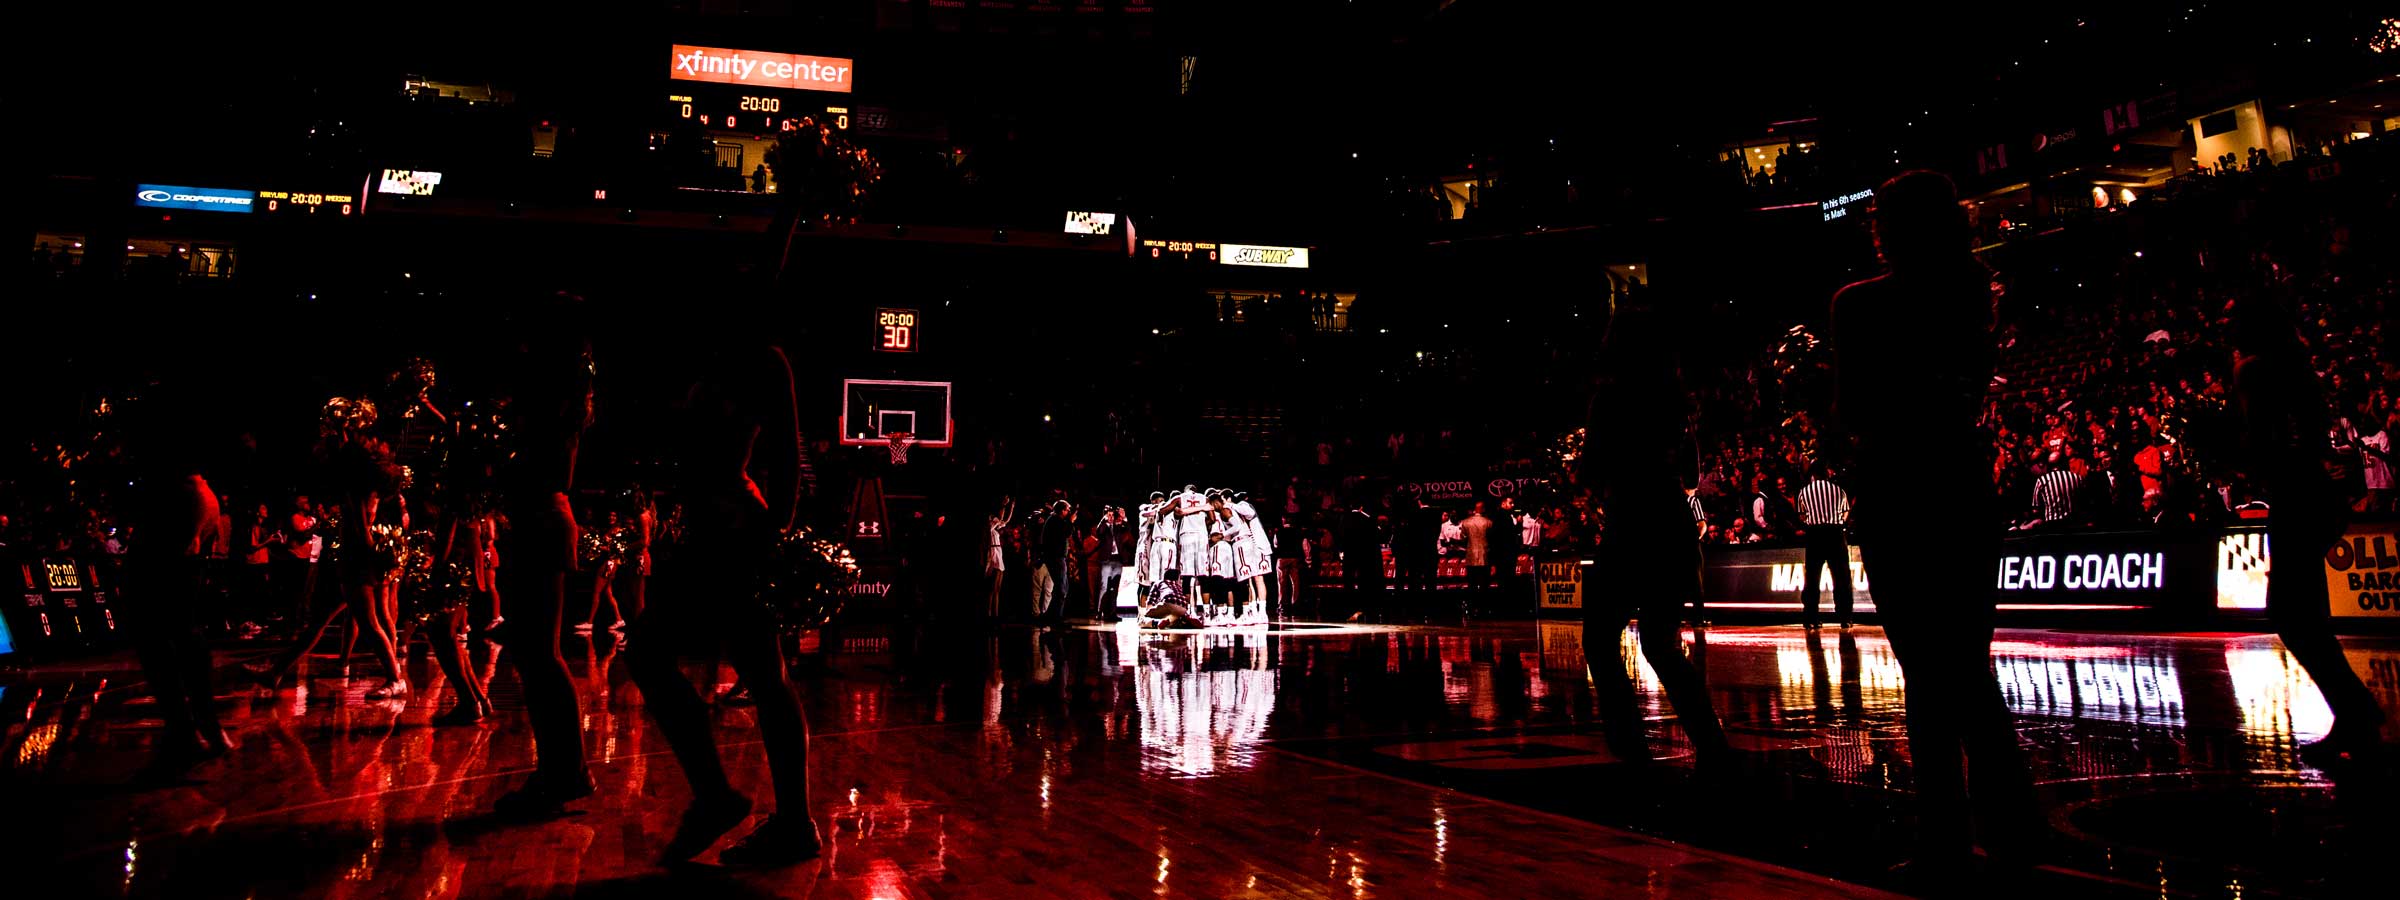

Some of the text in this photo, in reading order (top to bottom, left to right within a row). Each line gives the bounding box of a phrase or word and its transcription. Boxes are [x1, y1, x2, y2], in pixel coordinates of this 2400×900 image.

[676, 50, 848, 83] xfinity center
[682, 104, 692, 118] 0
[740, 96, 780, 113] 20:00
[700, 115, 790, 131] 4 0 1 0
[838, 115, 848, 129] 0
[291, 192, 322, 205] 20:00
[595, 189, 606, 199] M
[268, 200, 277, 211] 0
[342, 204, 351, 215] 0
[1152, 248, 1159, 258] 0
[1210, 251, 1217, 260] 0
[1168, 241, 1193, 252] 20:00
[1235, 248, 1295, 264] SUBWAY
[880, 312, 914, 327] 20:00
[883, 325, 909, 348] 30
[1424, 481, 1472, 493] TOYOTA
[46, 563, 78, 587] 20:00
[2063, 552, 2163, 589] COACH
